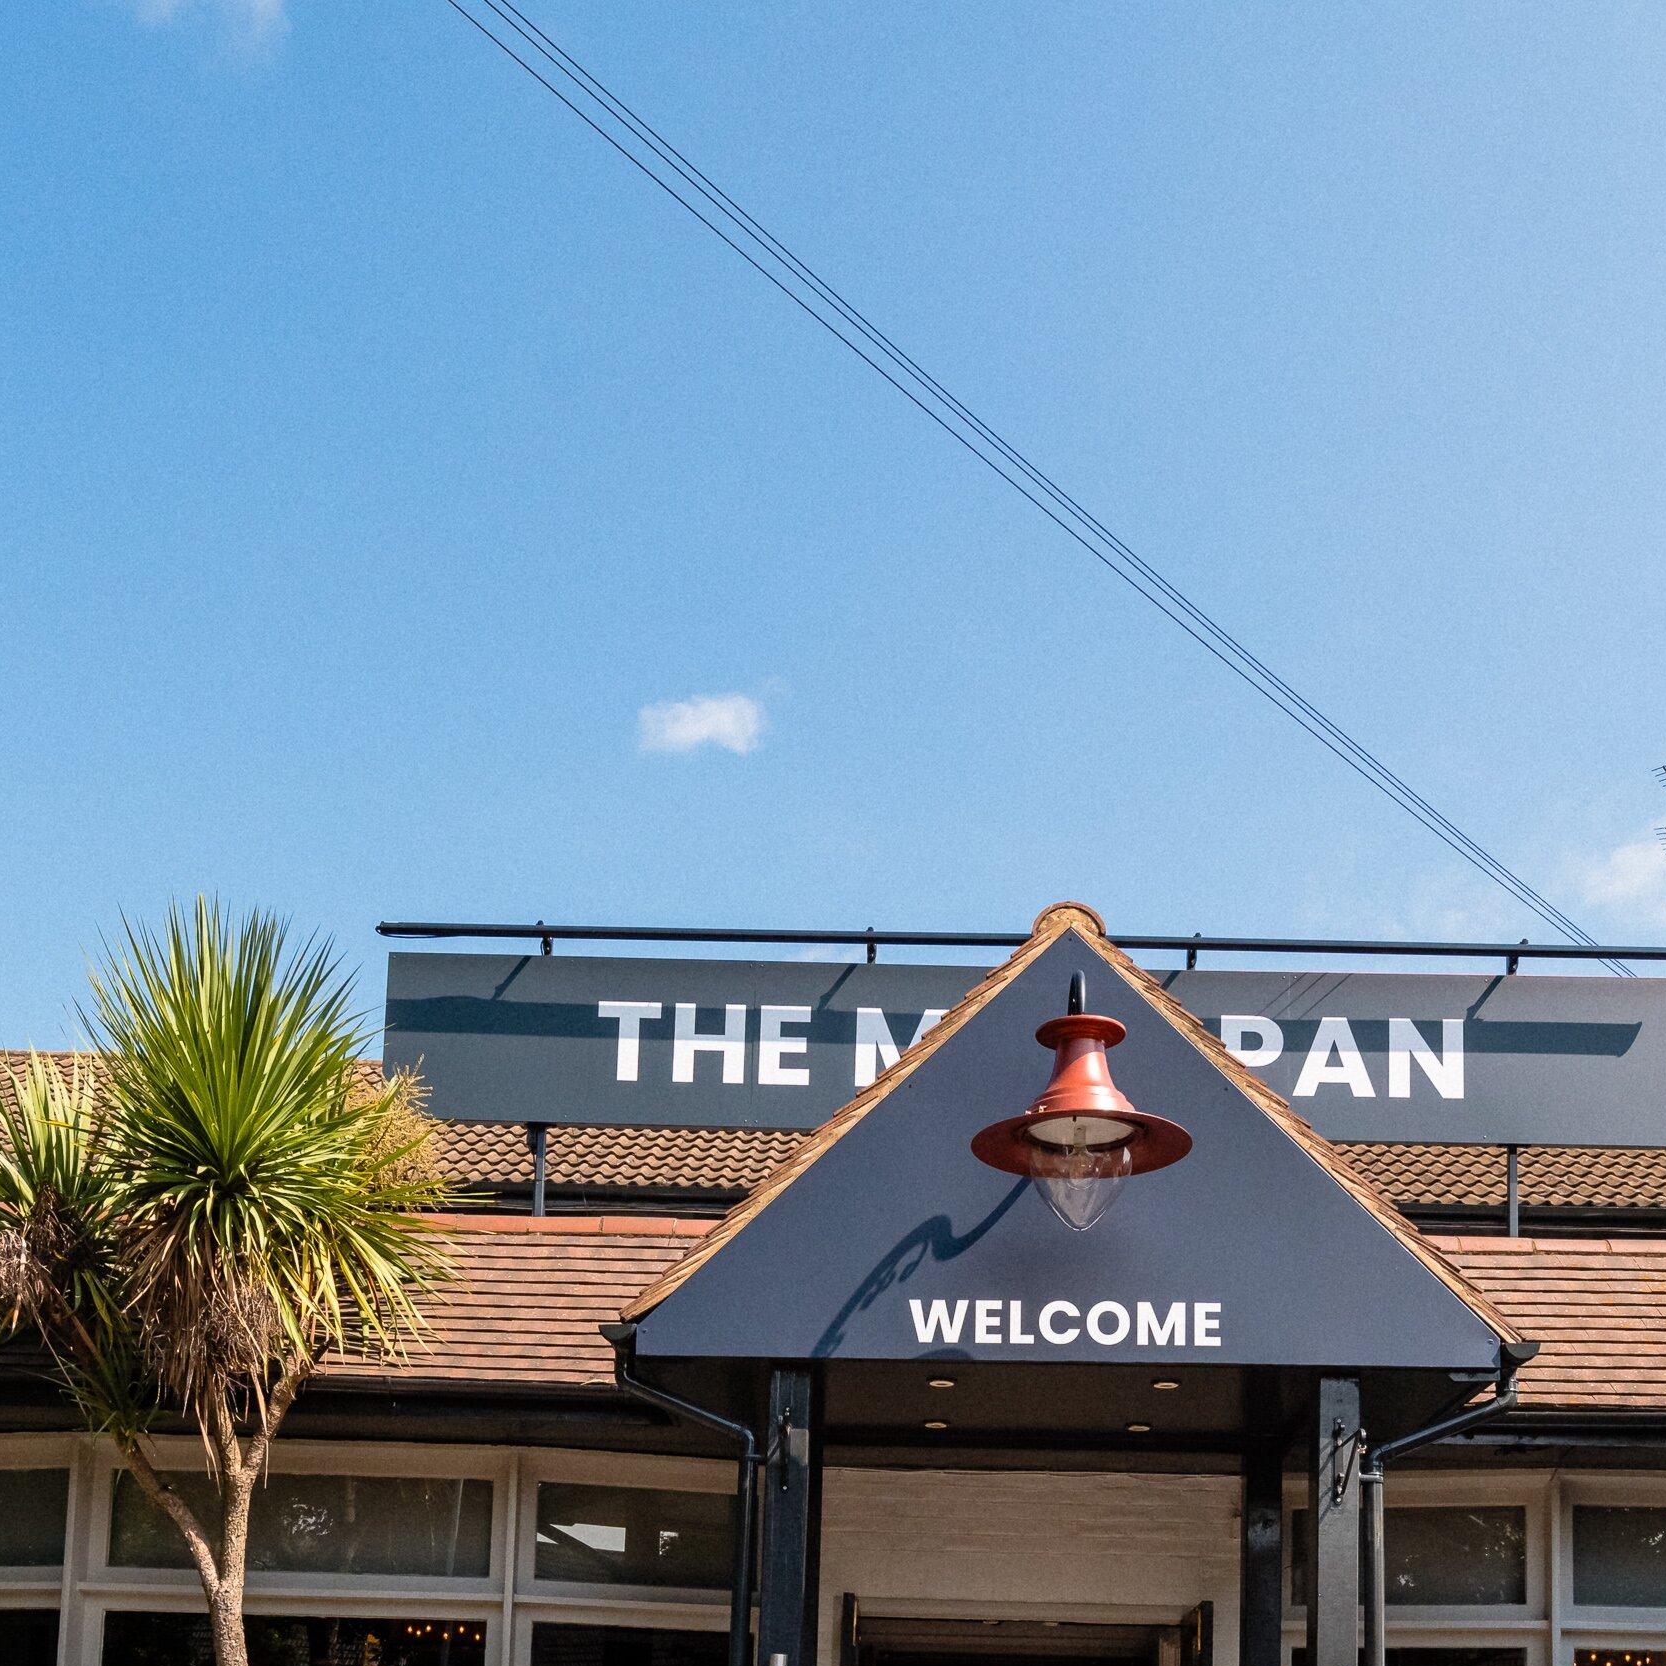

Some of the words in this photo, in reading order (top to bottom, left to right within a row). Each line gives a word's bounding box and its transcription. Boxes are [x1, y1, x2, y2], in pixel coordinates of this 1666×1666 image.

[597, 1001, 812, 1086] THE
[854, 1006, 1465, 1100] MPAN
[908, 1298, 1222, 1347] WELCOME
